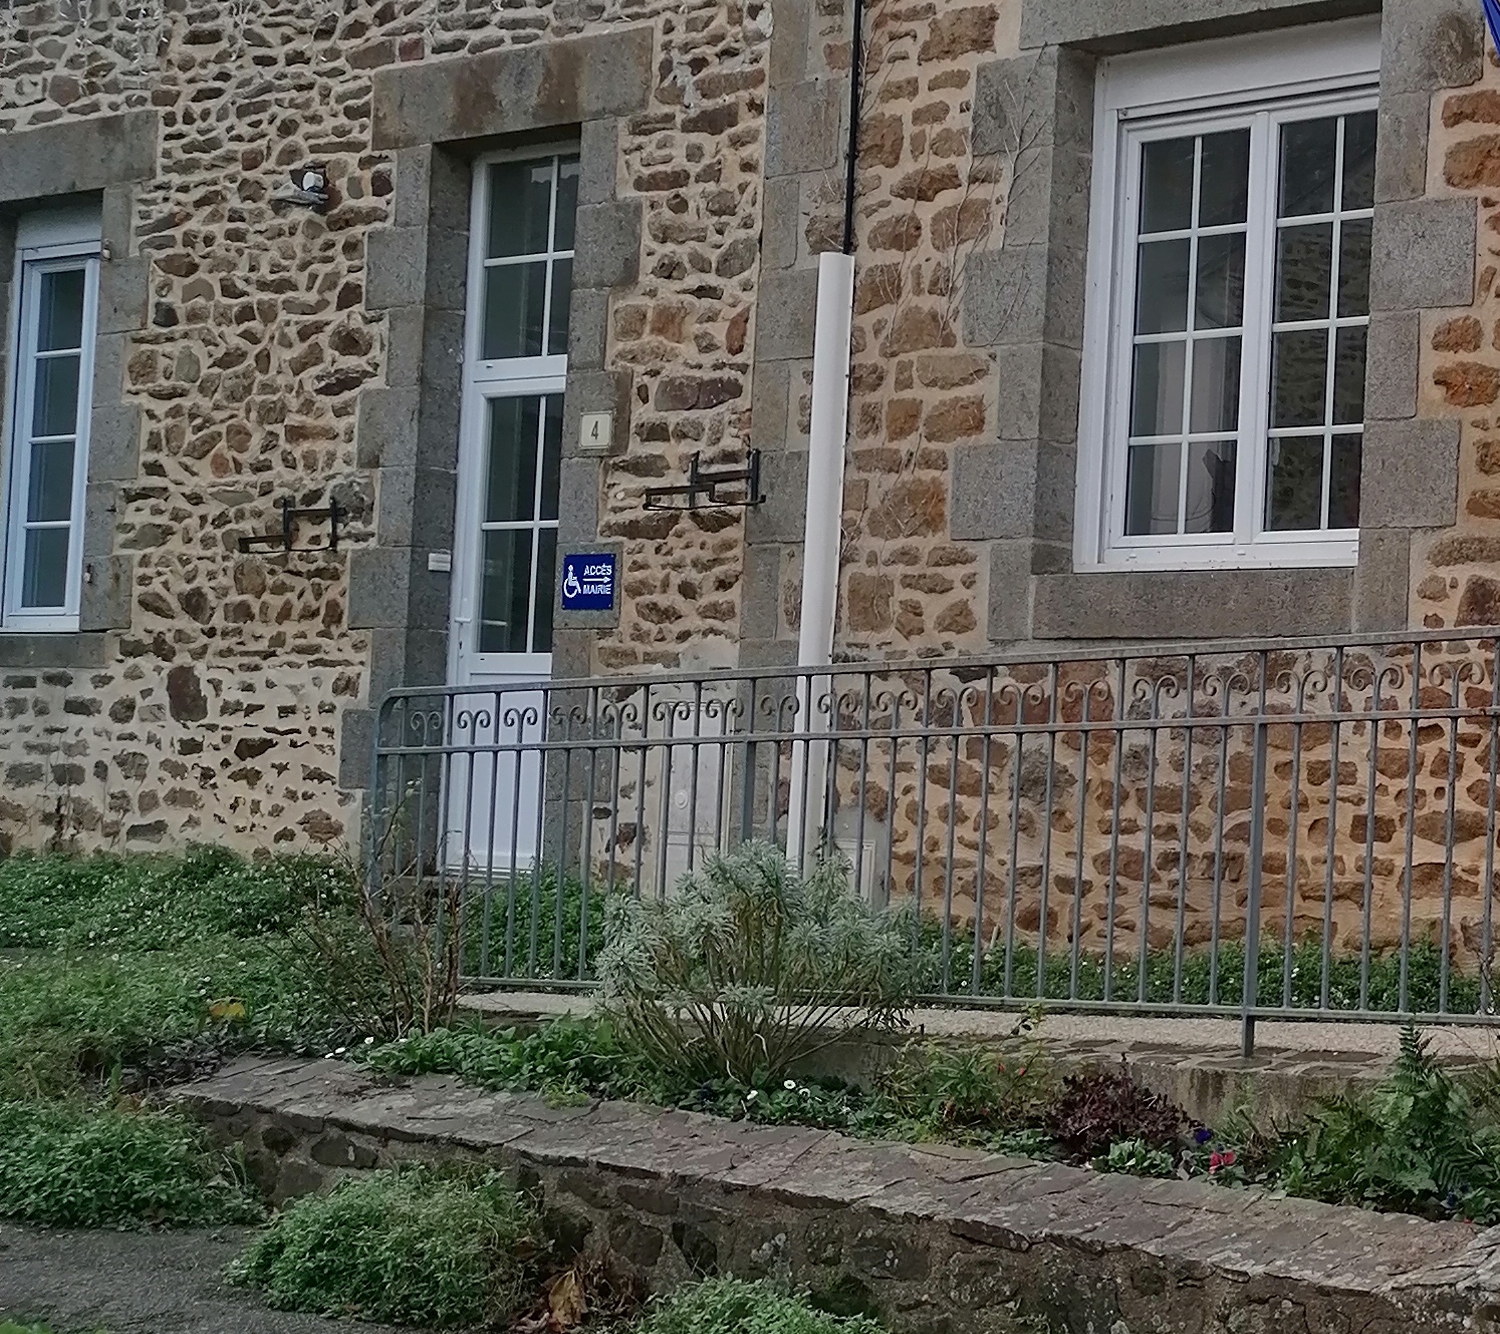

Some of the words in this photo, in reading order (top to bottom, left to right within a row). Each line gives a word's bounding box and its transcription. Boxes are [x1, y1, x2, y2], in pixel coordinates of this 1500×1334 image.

[590, 420, 599, 440] 4
[583, 563, 613, 576] ACCÈS
[582, 584, 612, 595] MAIRIE
